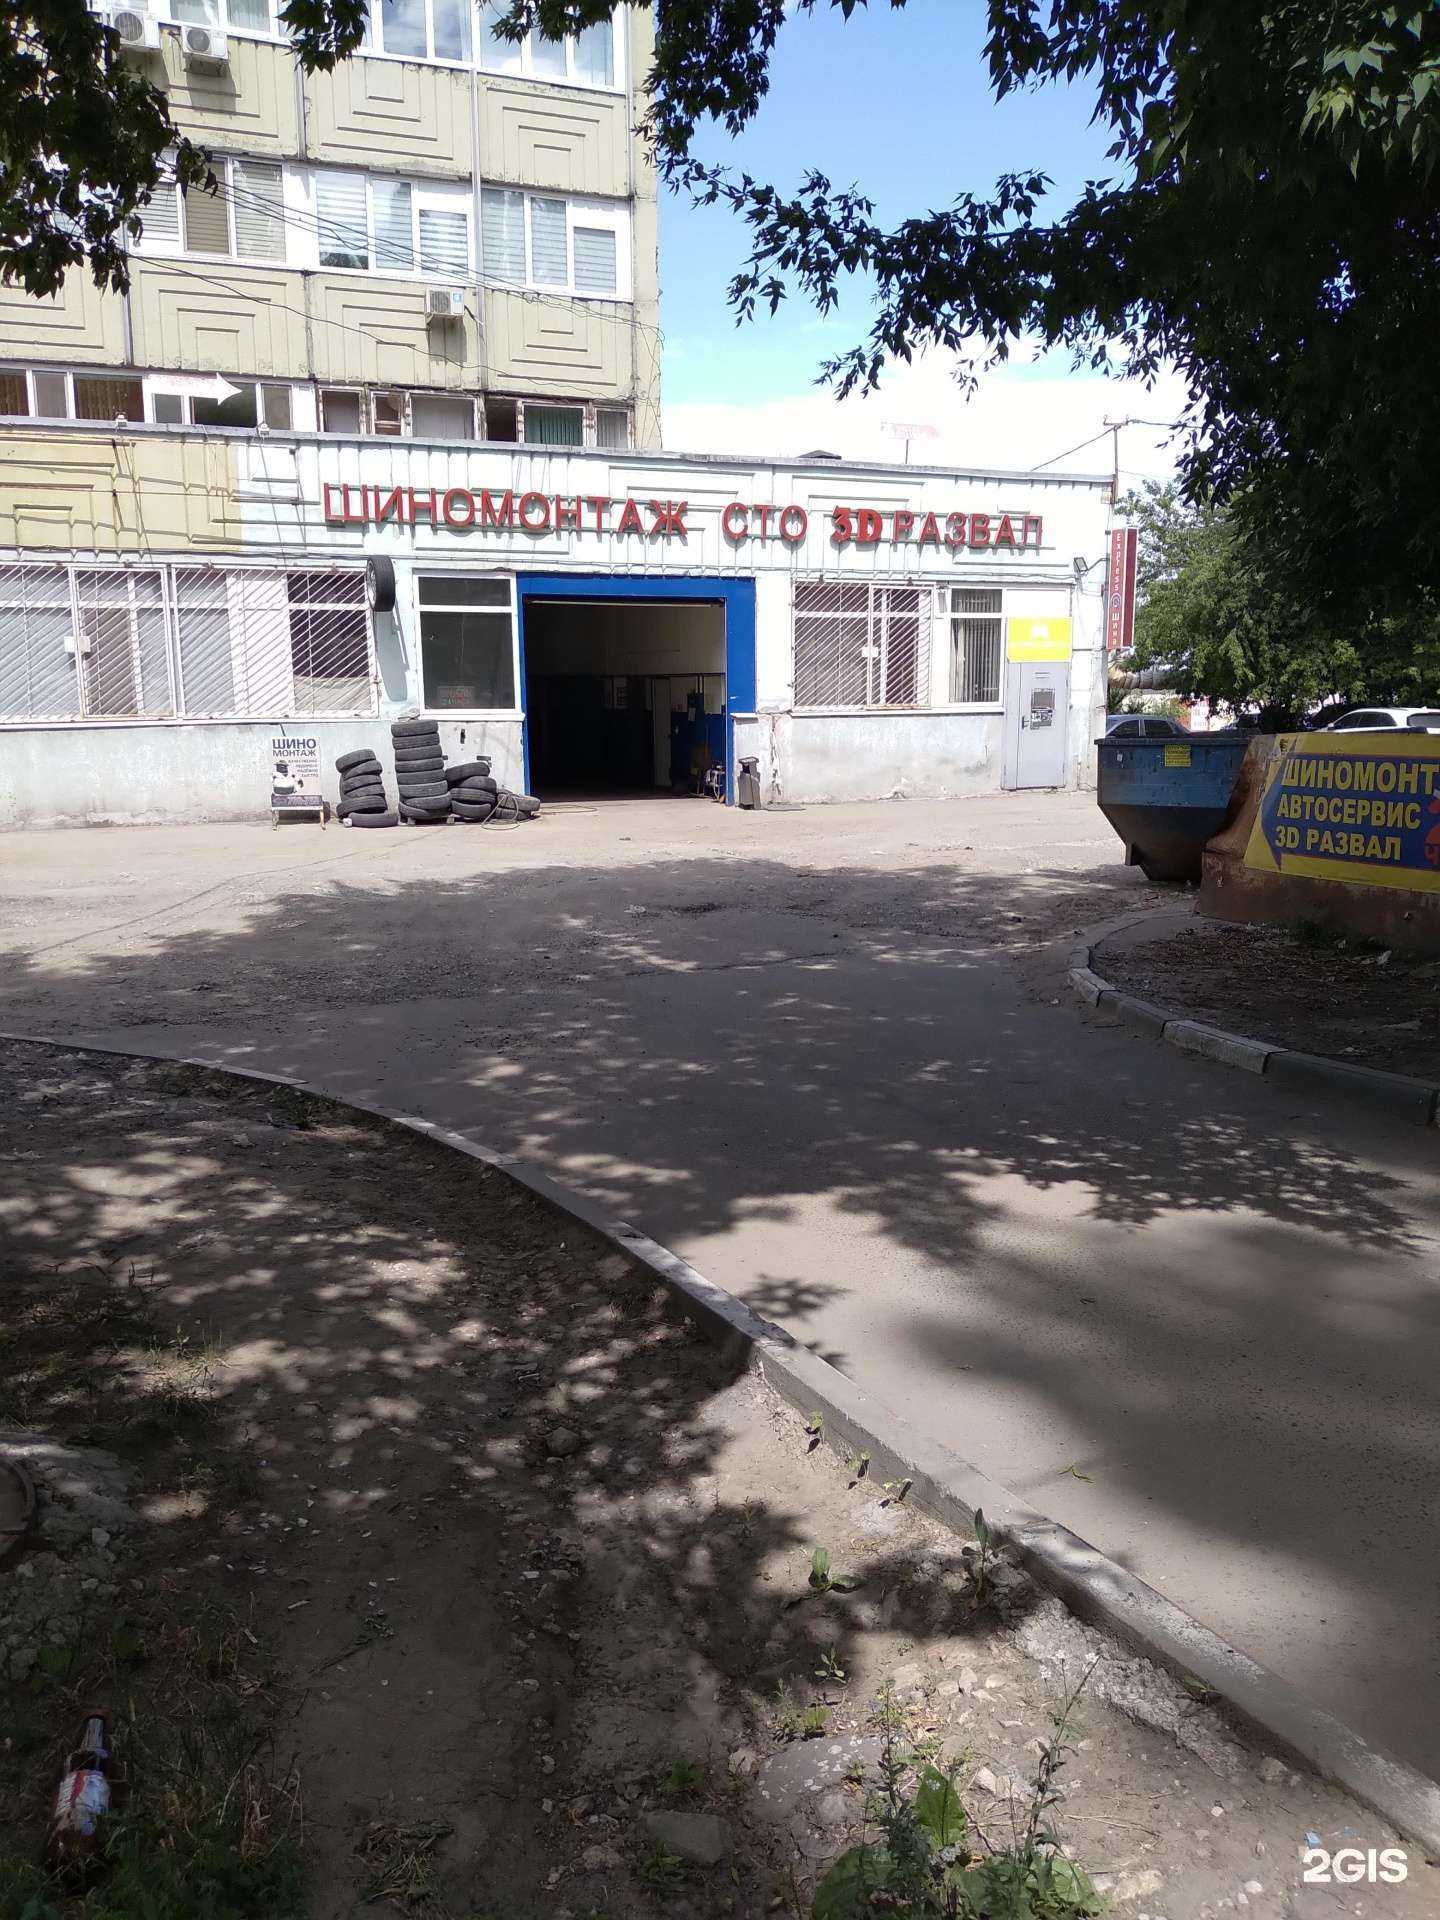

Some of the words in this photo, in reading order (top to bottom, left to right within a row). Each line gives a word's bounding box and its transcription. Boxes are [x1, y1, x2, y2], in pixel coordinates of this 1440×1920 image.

[323, 482, 688, 536] ШИНОМОНТАЖ
[722, 502, 808, 541] СТО
[831, 505, 884, 543] 3D
[893, 511, 1043, 547] РАЗВАЛ
[272, 739, 317, 750] ШИНО
[272, 749, 317, 757] МОНТАЖ
[1281, 758, 1440, 795] ШИНОМОНТ
[1277, 794, 1421, 830] АВТОСЕРВИС
[1275, 825, 1300, 849] 3D
[1306, 829, 1401, 860] РАЗВАЛ
